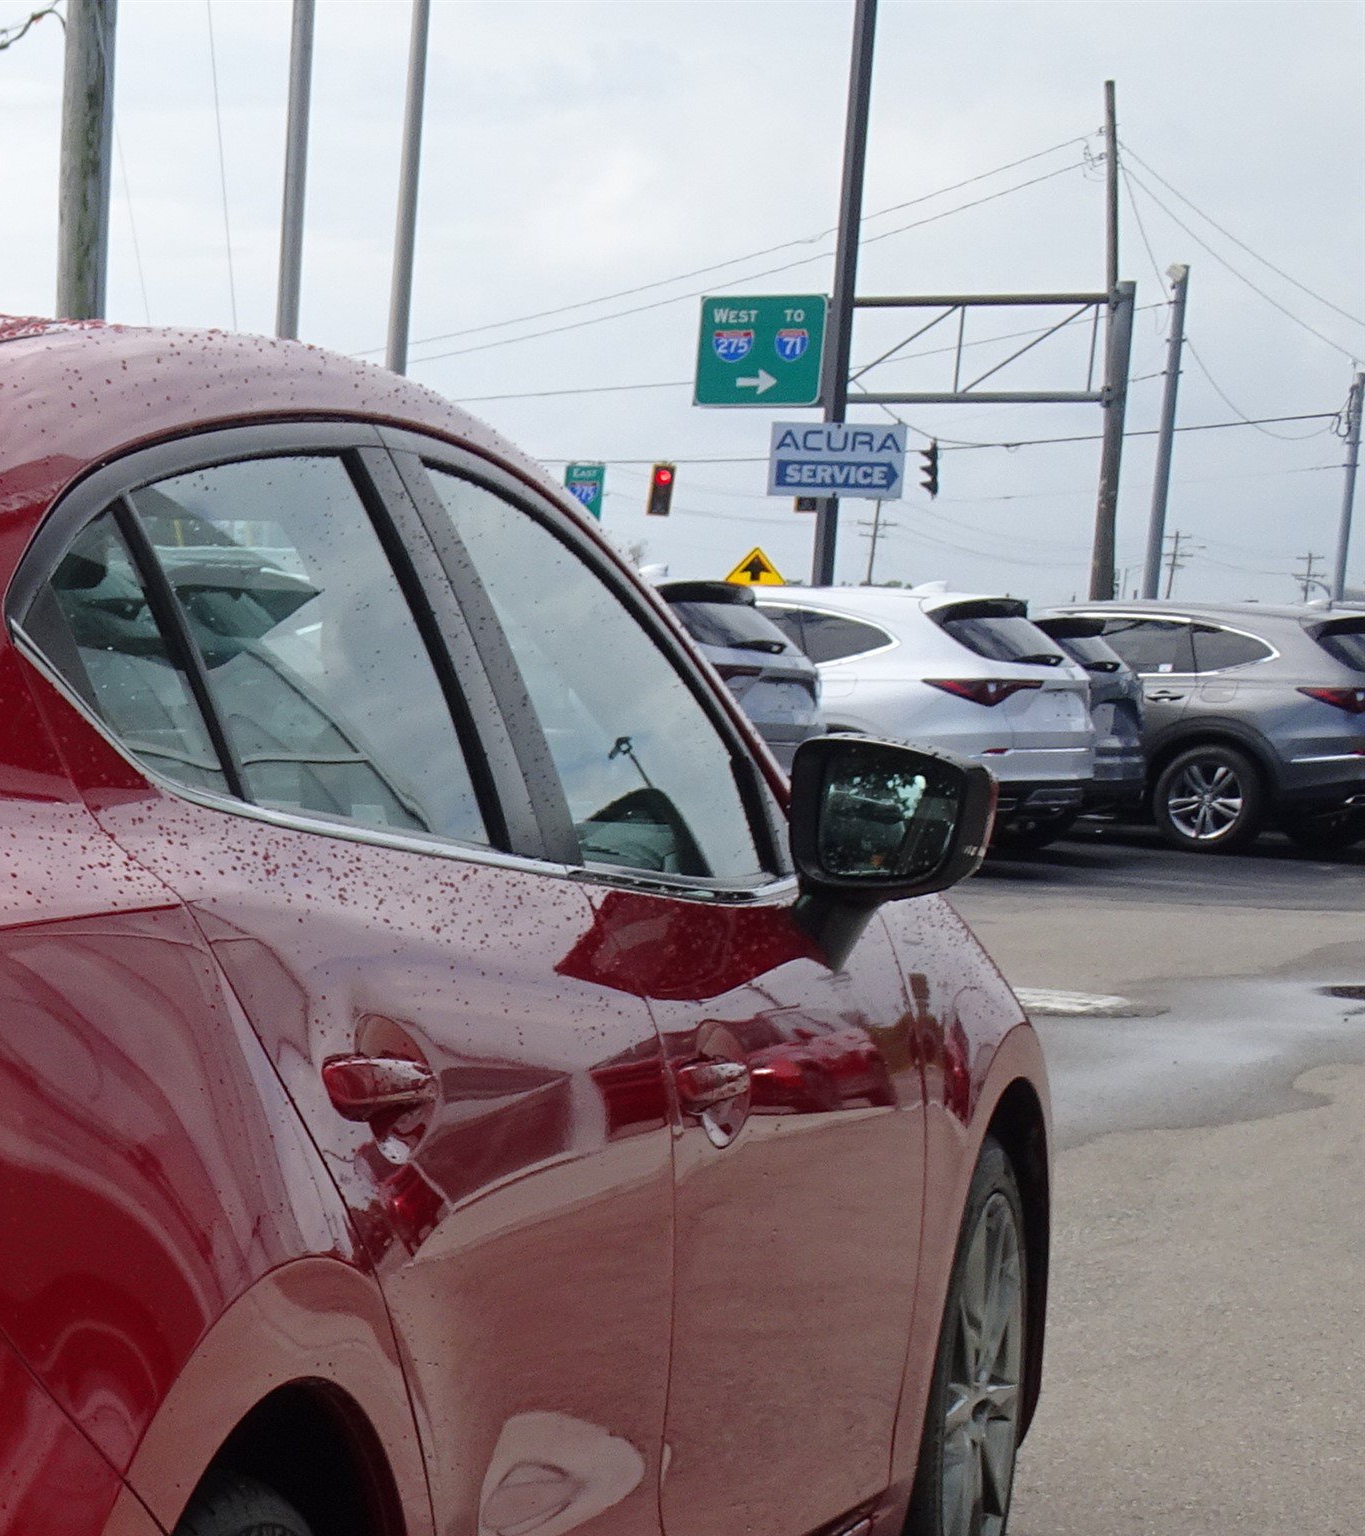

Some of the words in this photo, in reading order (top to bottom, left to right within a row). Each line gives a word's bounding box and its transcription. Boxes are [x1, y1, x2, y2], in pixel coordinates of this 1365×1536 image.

[713, 308, 758, 323] WEST
[784, 308, 805, 322] TO
[716, 338, 750, 353] 275
[782, 337, 802, 355] 71
[775, 429, 902, 453] ACURA
[784, 463, 888, 485] SERVICE
